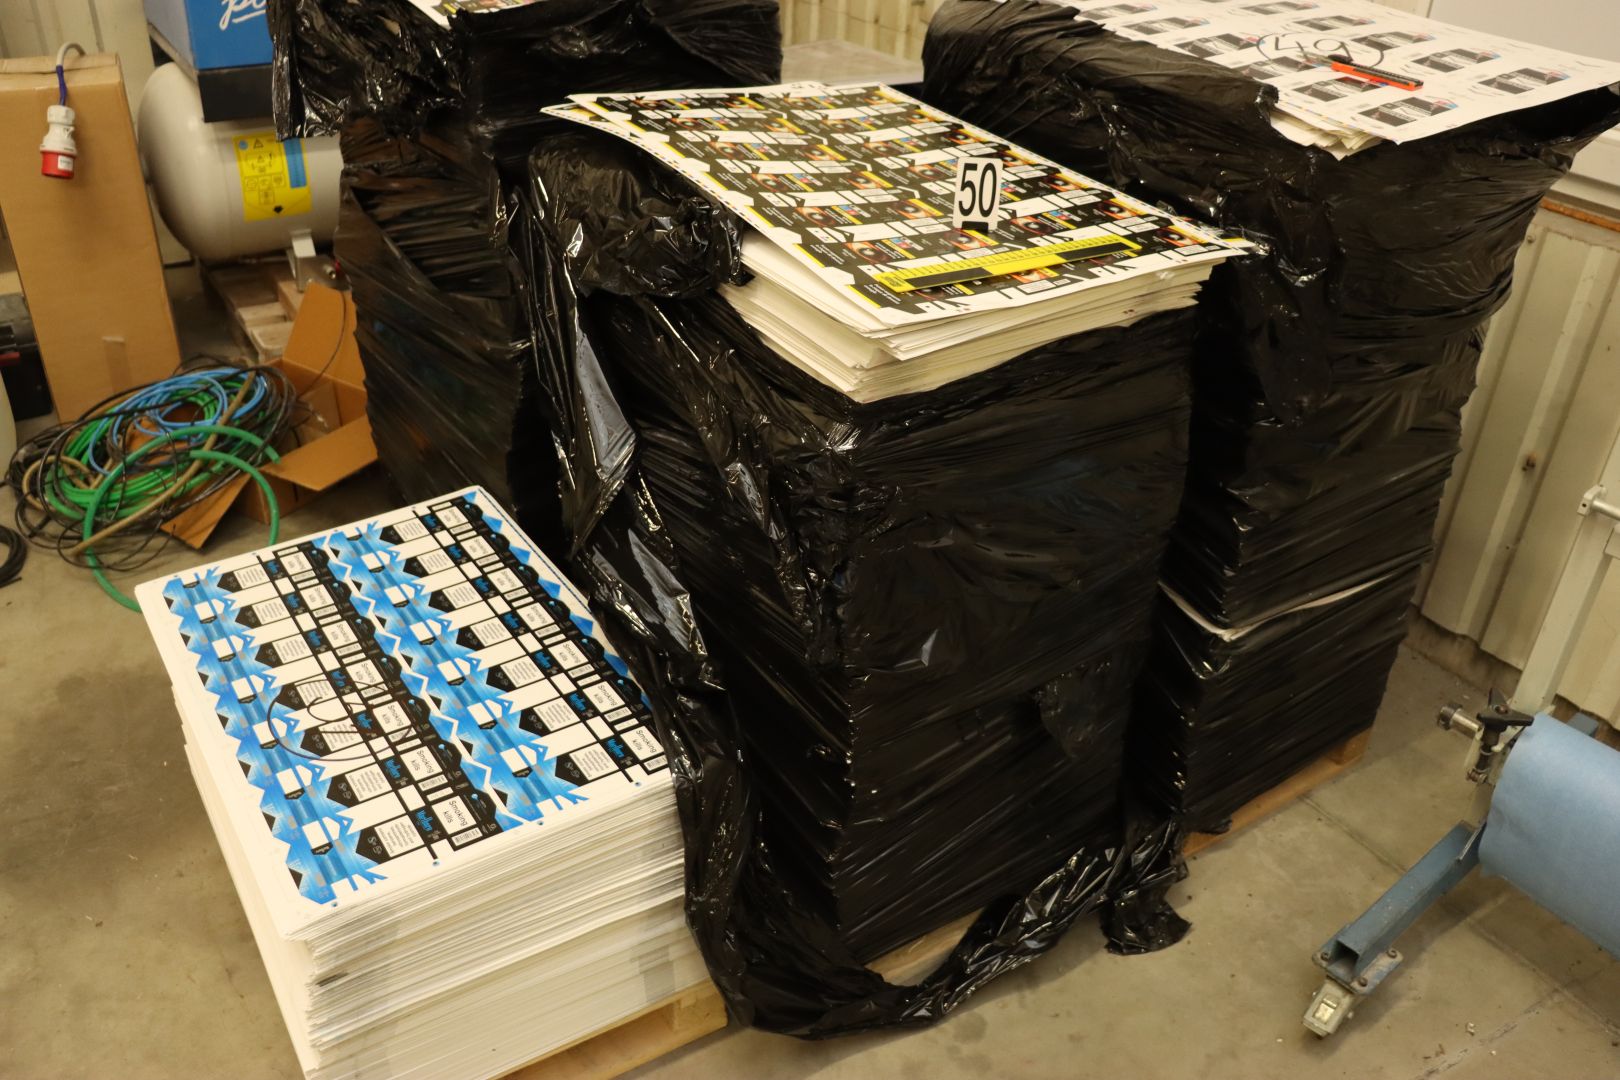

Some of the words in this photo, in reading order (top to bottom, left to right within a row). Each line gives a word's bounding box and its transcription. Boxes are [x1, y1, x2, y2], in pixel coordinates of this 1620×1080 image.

[1275, 36, 1354, 62] 49
[957, 162, 997, 218] 50
[596, 684, 618, 706] Smoking
[631, 738, 643, 751] kills
[634, 729, 657, 753] Smoking
[410, 758, 421, 771] kills
[415, 749, 435, 774] Smoking
[442, 810, 453, 823] kills
[447, 799, 468, 826] Smoking
